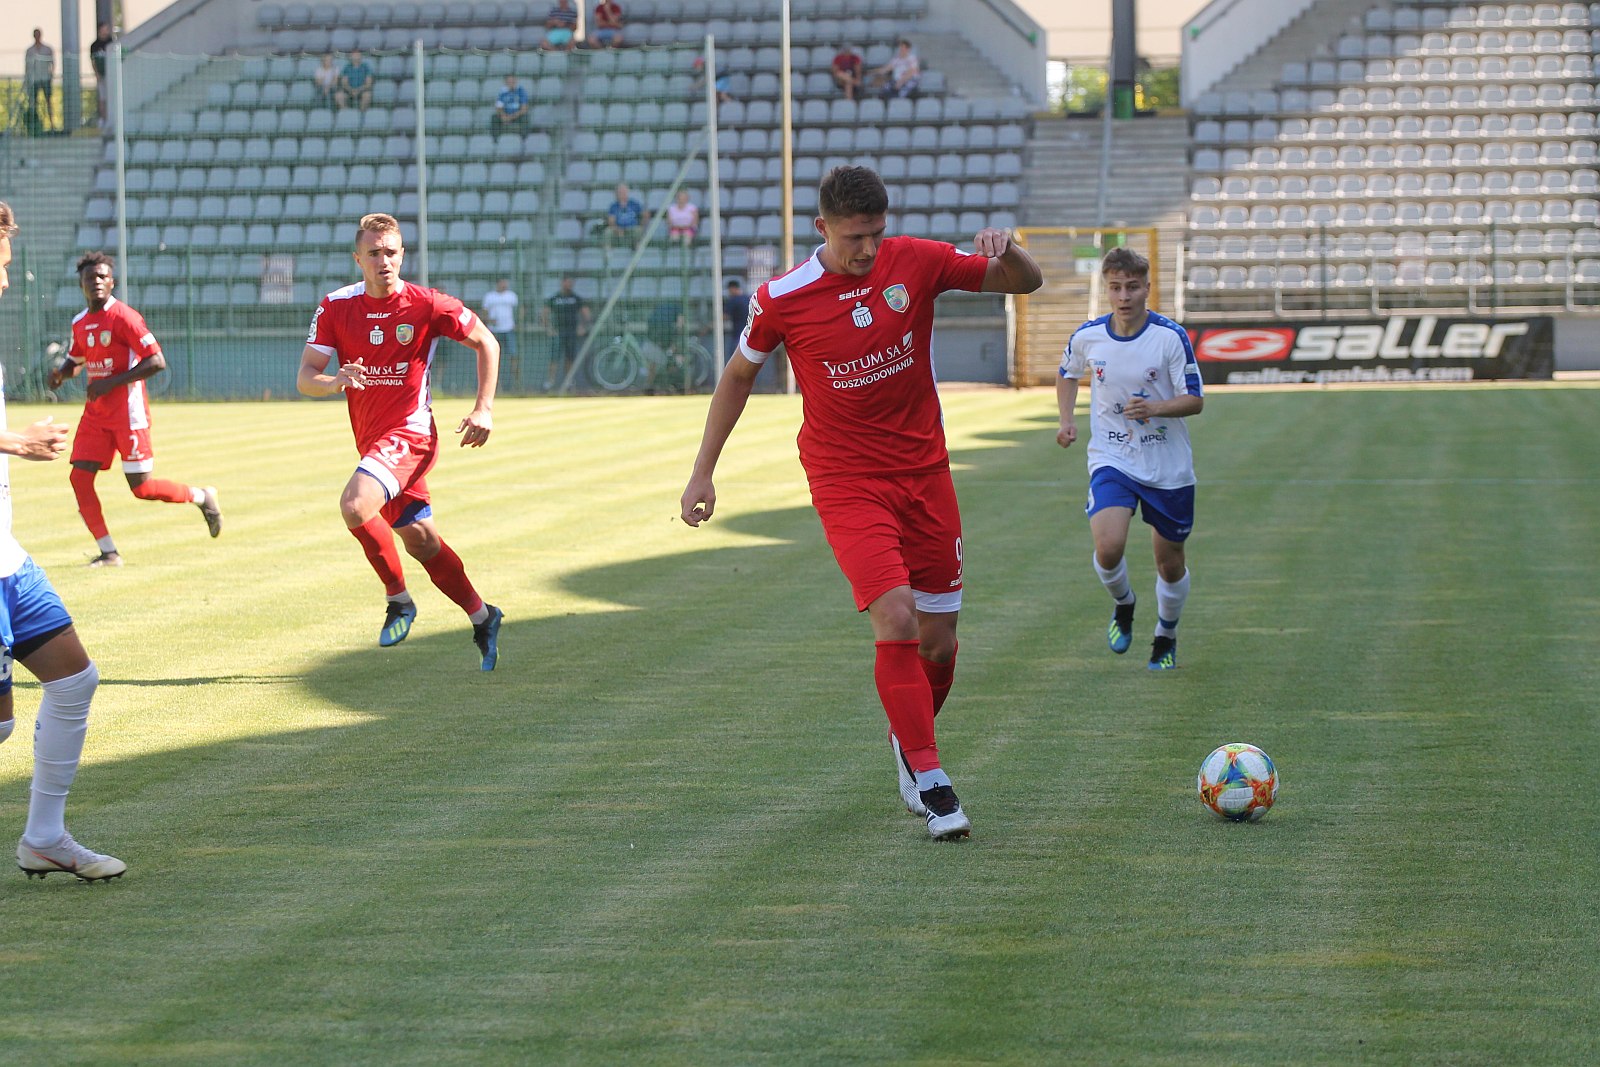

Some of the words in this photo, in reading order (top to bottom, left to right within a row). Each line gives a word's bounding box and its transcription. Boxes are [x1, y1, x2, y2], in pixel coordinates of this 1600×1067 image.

[839, 287, 873, 301] saller
[1290, 315, 1529, 361] saller
[822, 351, 884, 377] VOTUM
[886, 344, 901, 360] SA
[833, 356, 915, 389] ODSZKODOWANIA
[380, 435, 410, 465] 22
[955, 536, 963, 575] 9
